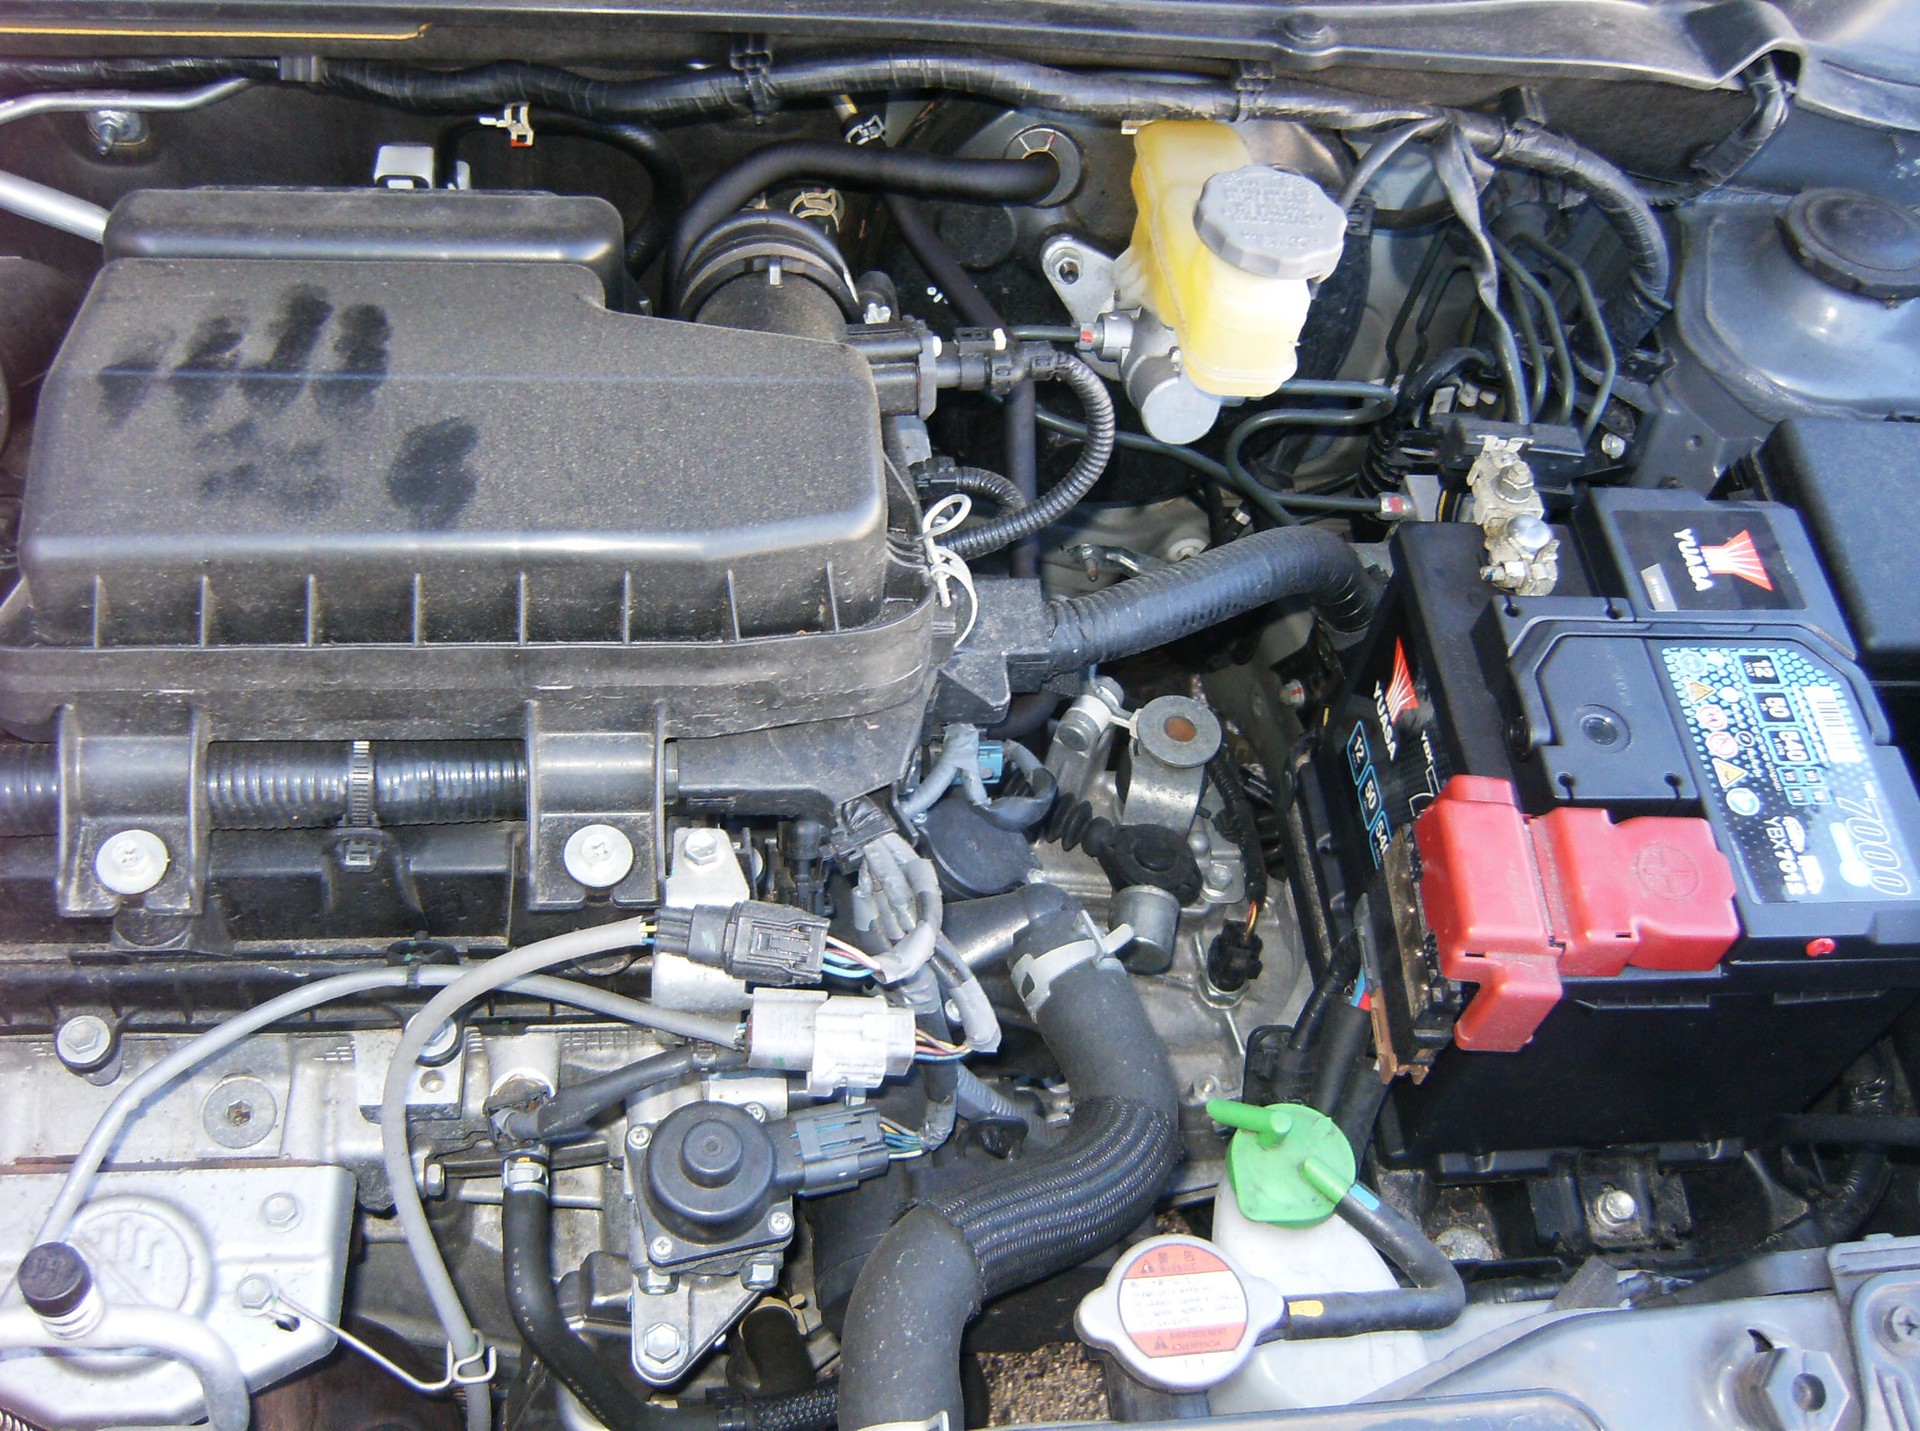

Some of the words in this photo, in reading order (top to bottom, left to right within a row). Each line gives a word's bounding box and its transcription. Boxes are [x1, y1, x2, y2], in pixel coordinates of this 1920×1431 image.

[1673, 528, 1714, 592] YUASA
[1752, 659, 1775, 678] 12
[1373, 680, 1396, 762] YUASA
[1765, 697, 1790, 718] 50
[1354, 735, 1365, 764] 12
[1421, 730, 1433, 763] YBX
[1778, 731, 1807, 761] 540
[1365, 779, 1377, 810] 50
[1836, 796, 1911, 895] 7000
